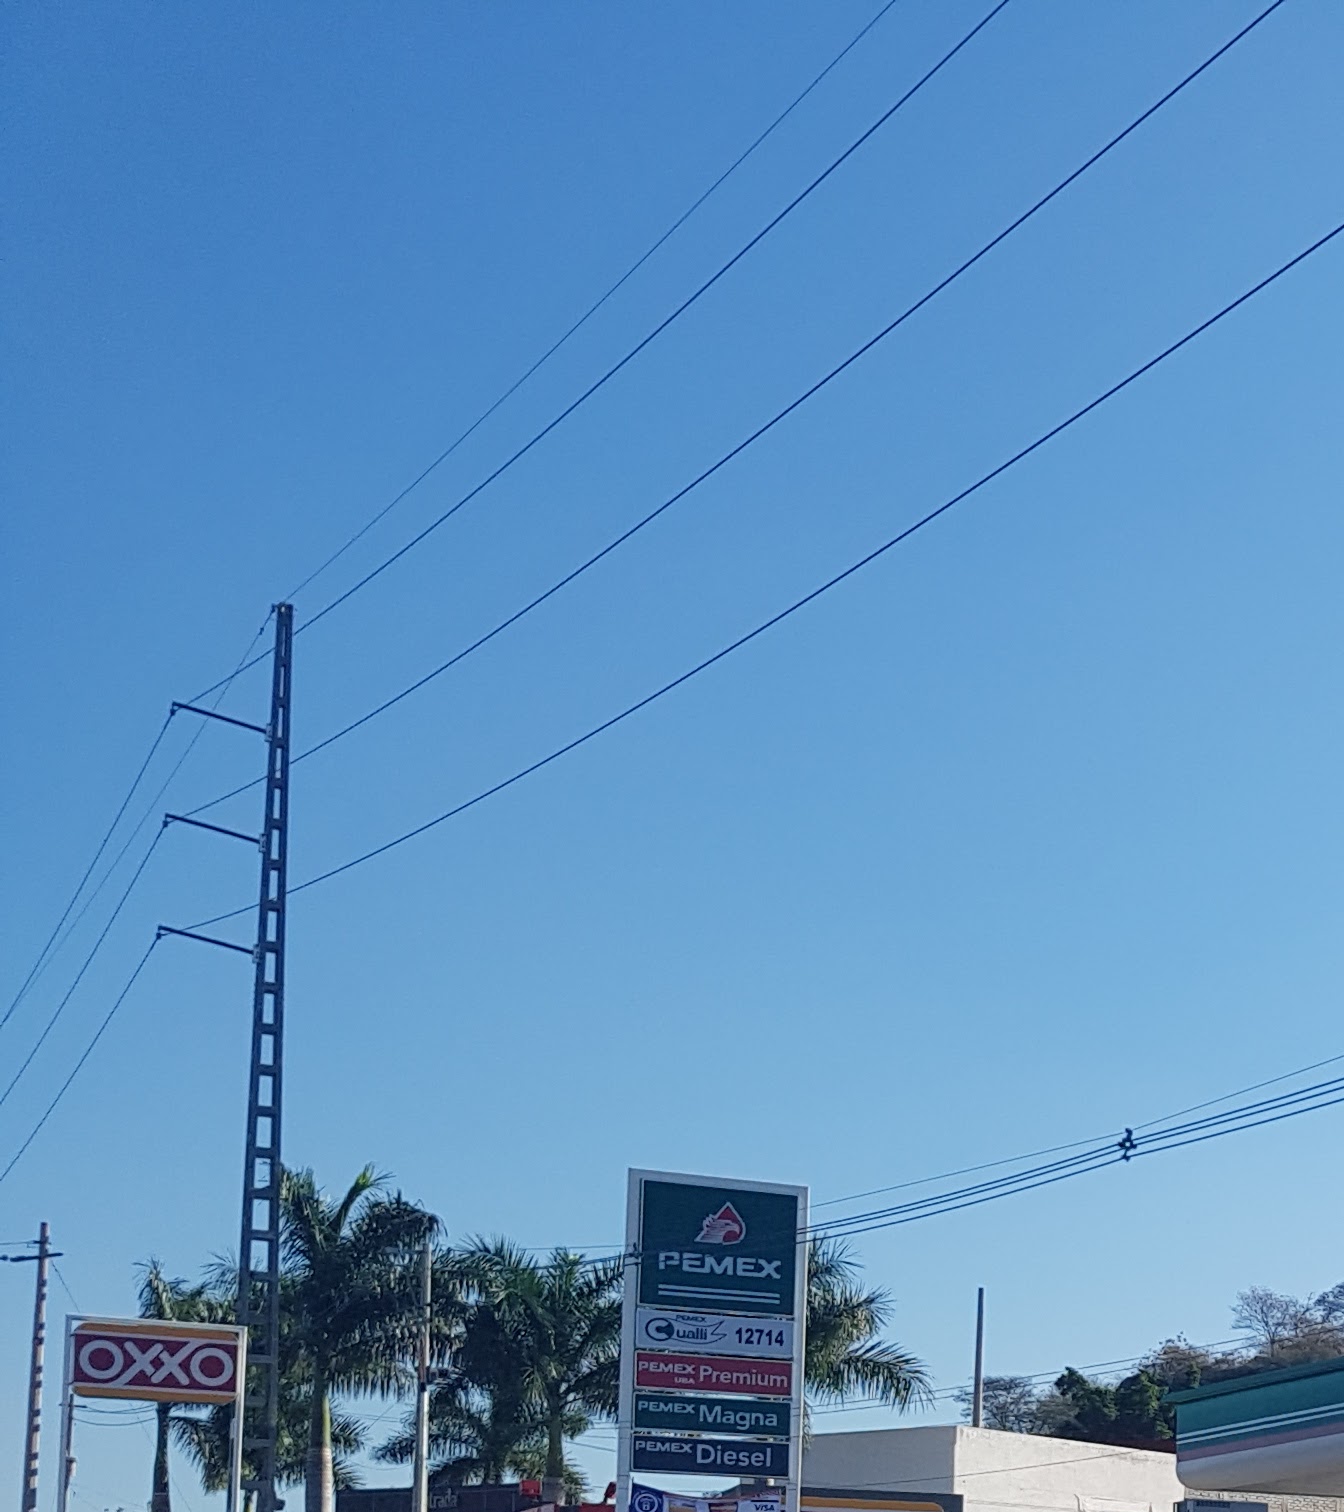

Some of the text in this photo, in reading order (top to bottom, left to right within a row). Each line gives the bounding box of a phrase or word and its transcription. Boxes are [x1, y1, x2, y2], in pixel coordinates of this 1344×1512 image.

[658, 1251, 782, 1280] PEMEX
[735, 1326, 785, 1347] 12714
[79, 1339, 234, 1387] OXXO
[638, 1360, 788, 1388] PEMEX Premium
[638, 1400, 778, 1431] PEMEX Magna
[635, 1440, 772, 1468] PEMEX Diesel
[754, 1503, 775, 1512] VISA
